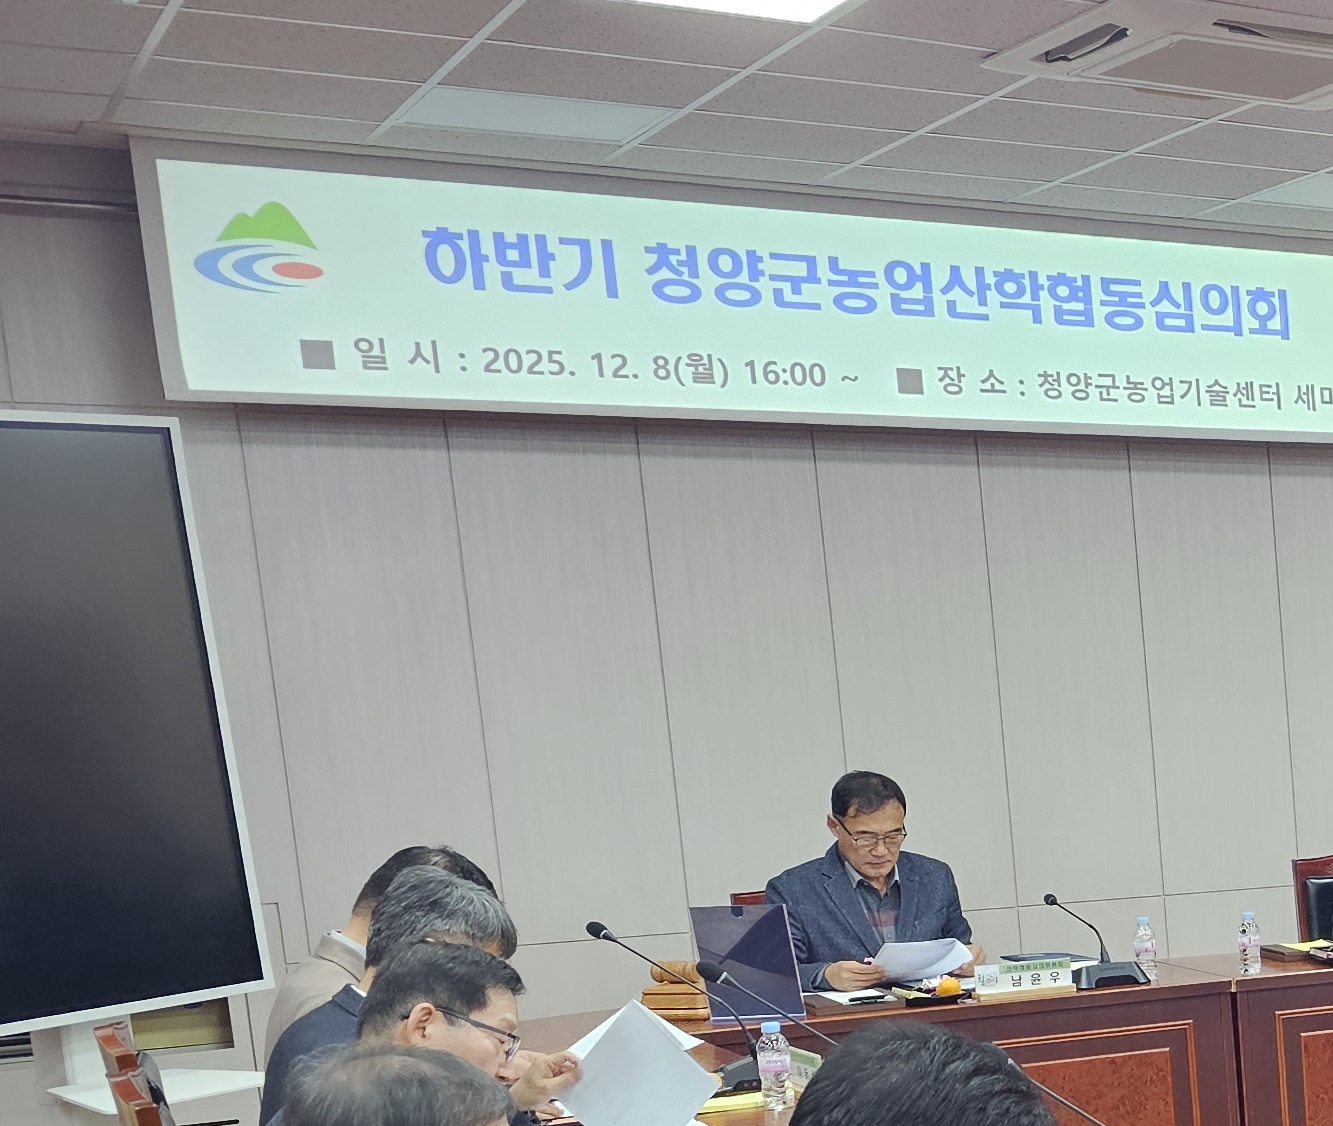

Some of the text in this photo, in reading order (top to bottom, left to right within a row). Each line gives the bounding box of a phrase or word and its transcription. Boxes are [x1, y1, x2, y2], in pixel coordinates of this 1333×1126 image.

[421, 226, 1292, 341] 하반기 청양군농업산학협동심의회
[481, 345, 577, 379] 2025.
[591, 350, 640, 380] 12.
[652, 352, 730, 388] 8(월)
[743, 358, 828, 390] 16:00
[1036, 369, 1283, 411] 청양군농업기술센터
